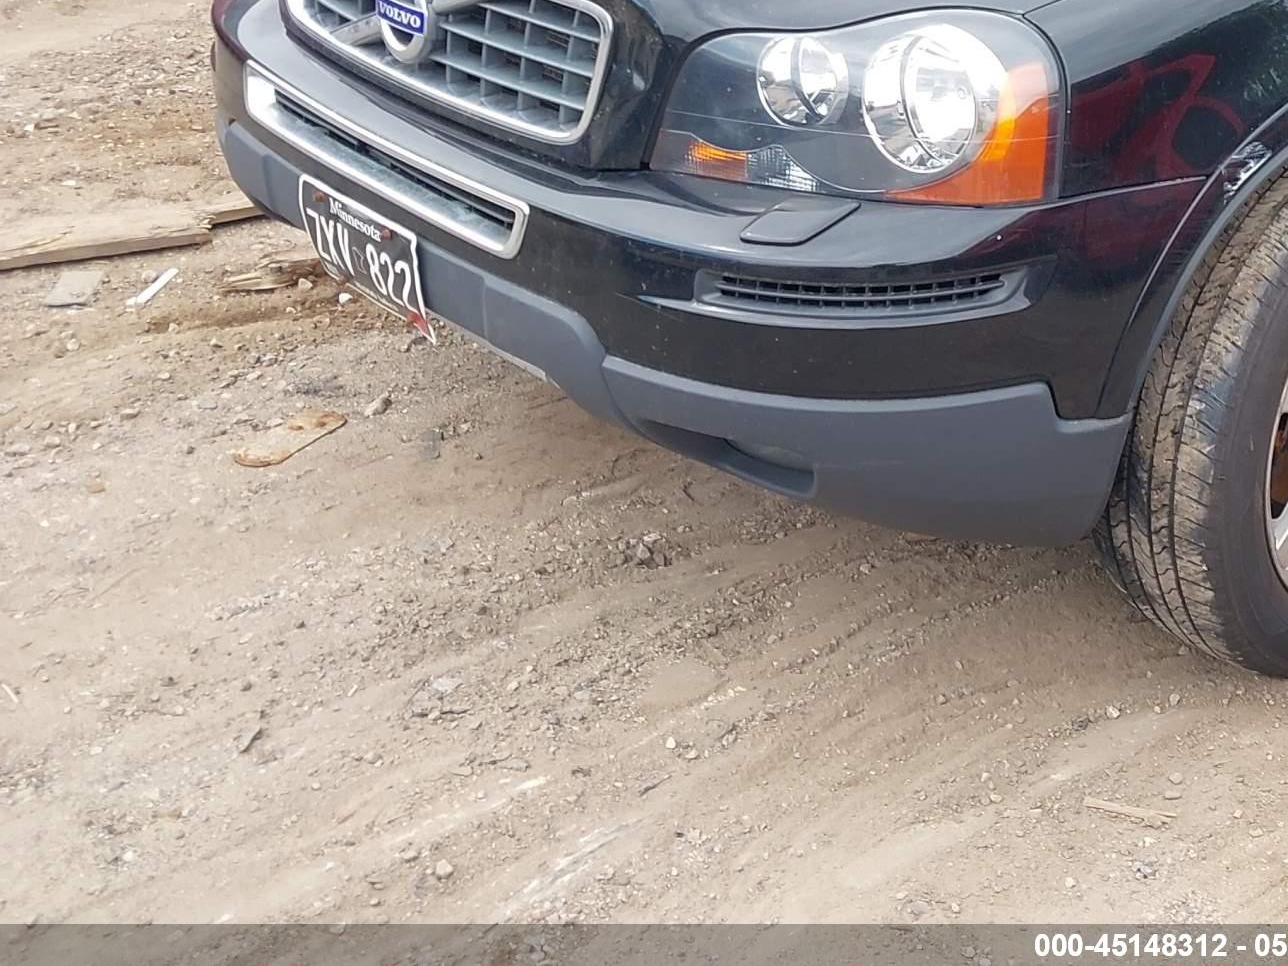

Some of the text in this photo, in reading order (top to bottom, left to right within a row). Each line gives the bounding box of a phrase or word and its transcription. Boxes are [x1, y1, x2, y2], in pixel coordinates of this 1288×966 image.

[378, 0, 421, 28] VOLVO
[329, 197, 382, 243] Minnesota
[365, 243, 420, 316] 822
